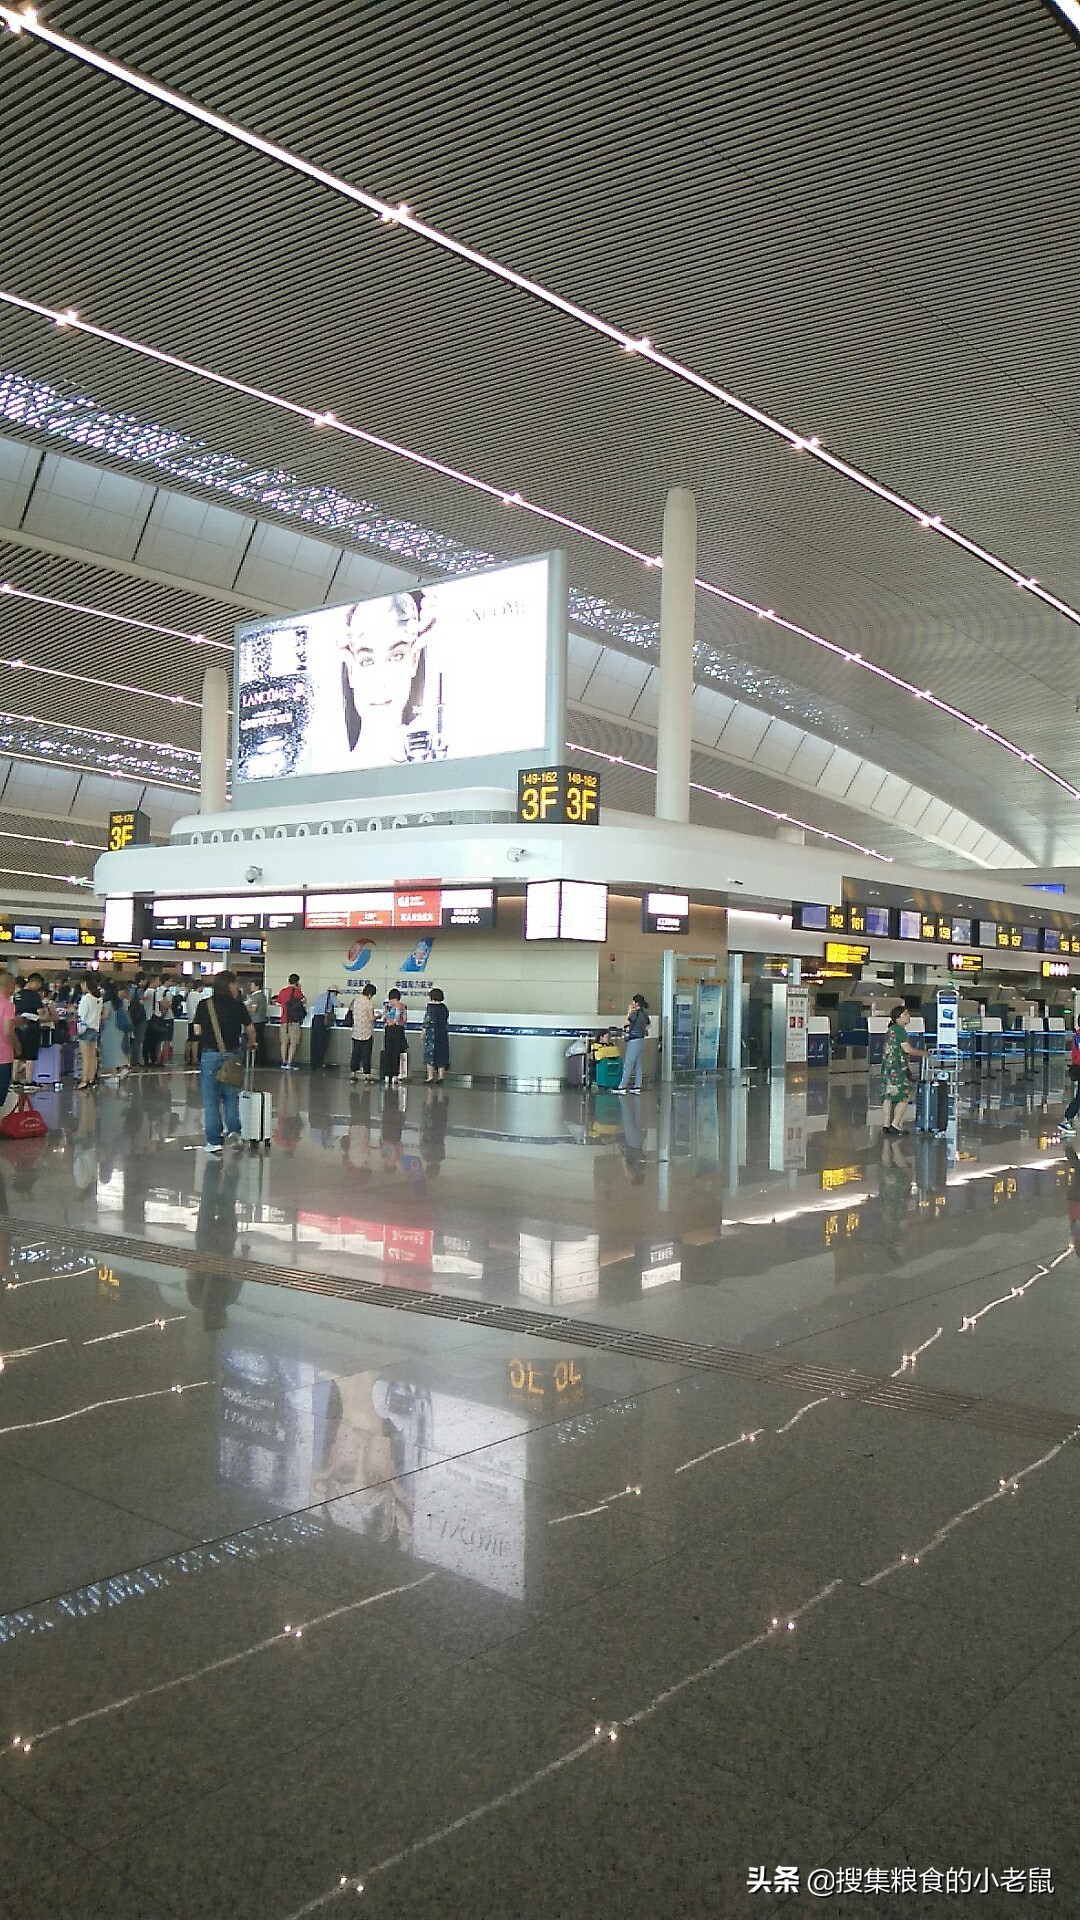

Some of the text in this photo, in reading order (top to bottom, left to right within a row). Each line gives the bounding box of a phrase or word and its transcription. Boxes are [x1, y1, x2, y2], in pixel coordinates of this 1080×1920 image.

[521, 786, 559, 821] 3F
[566, 787, 598, 821] 3F
[110, 824, 135, 851] 3F
[829, 913, 844, 929] 162
[851, 916, 865, 931] 161
